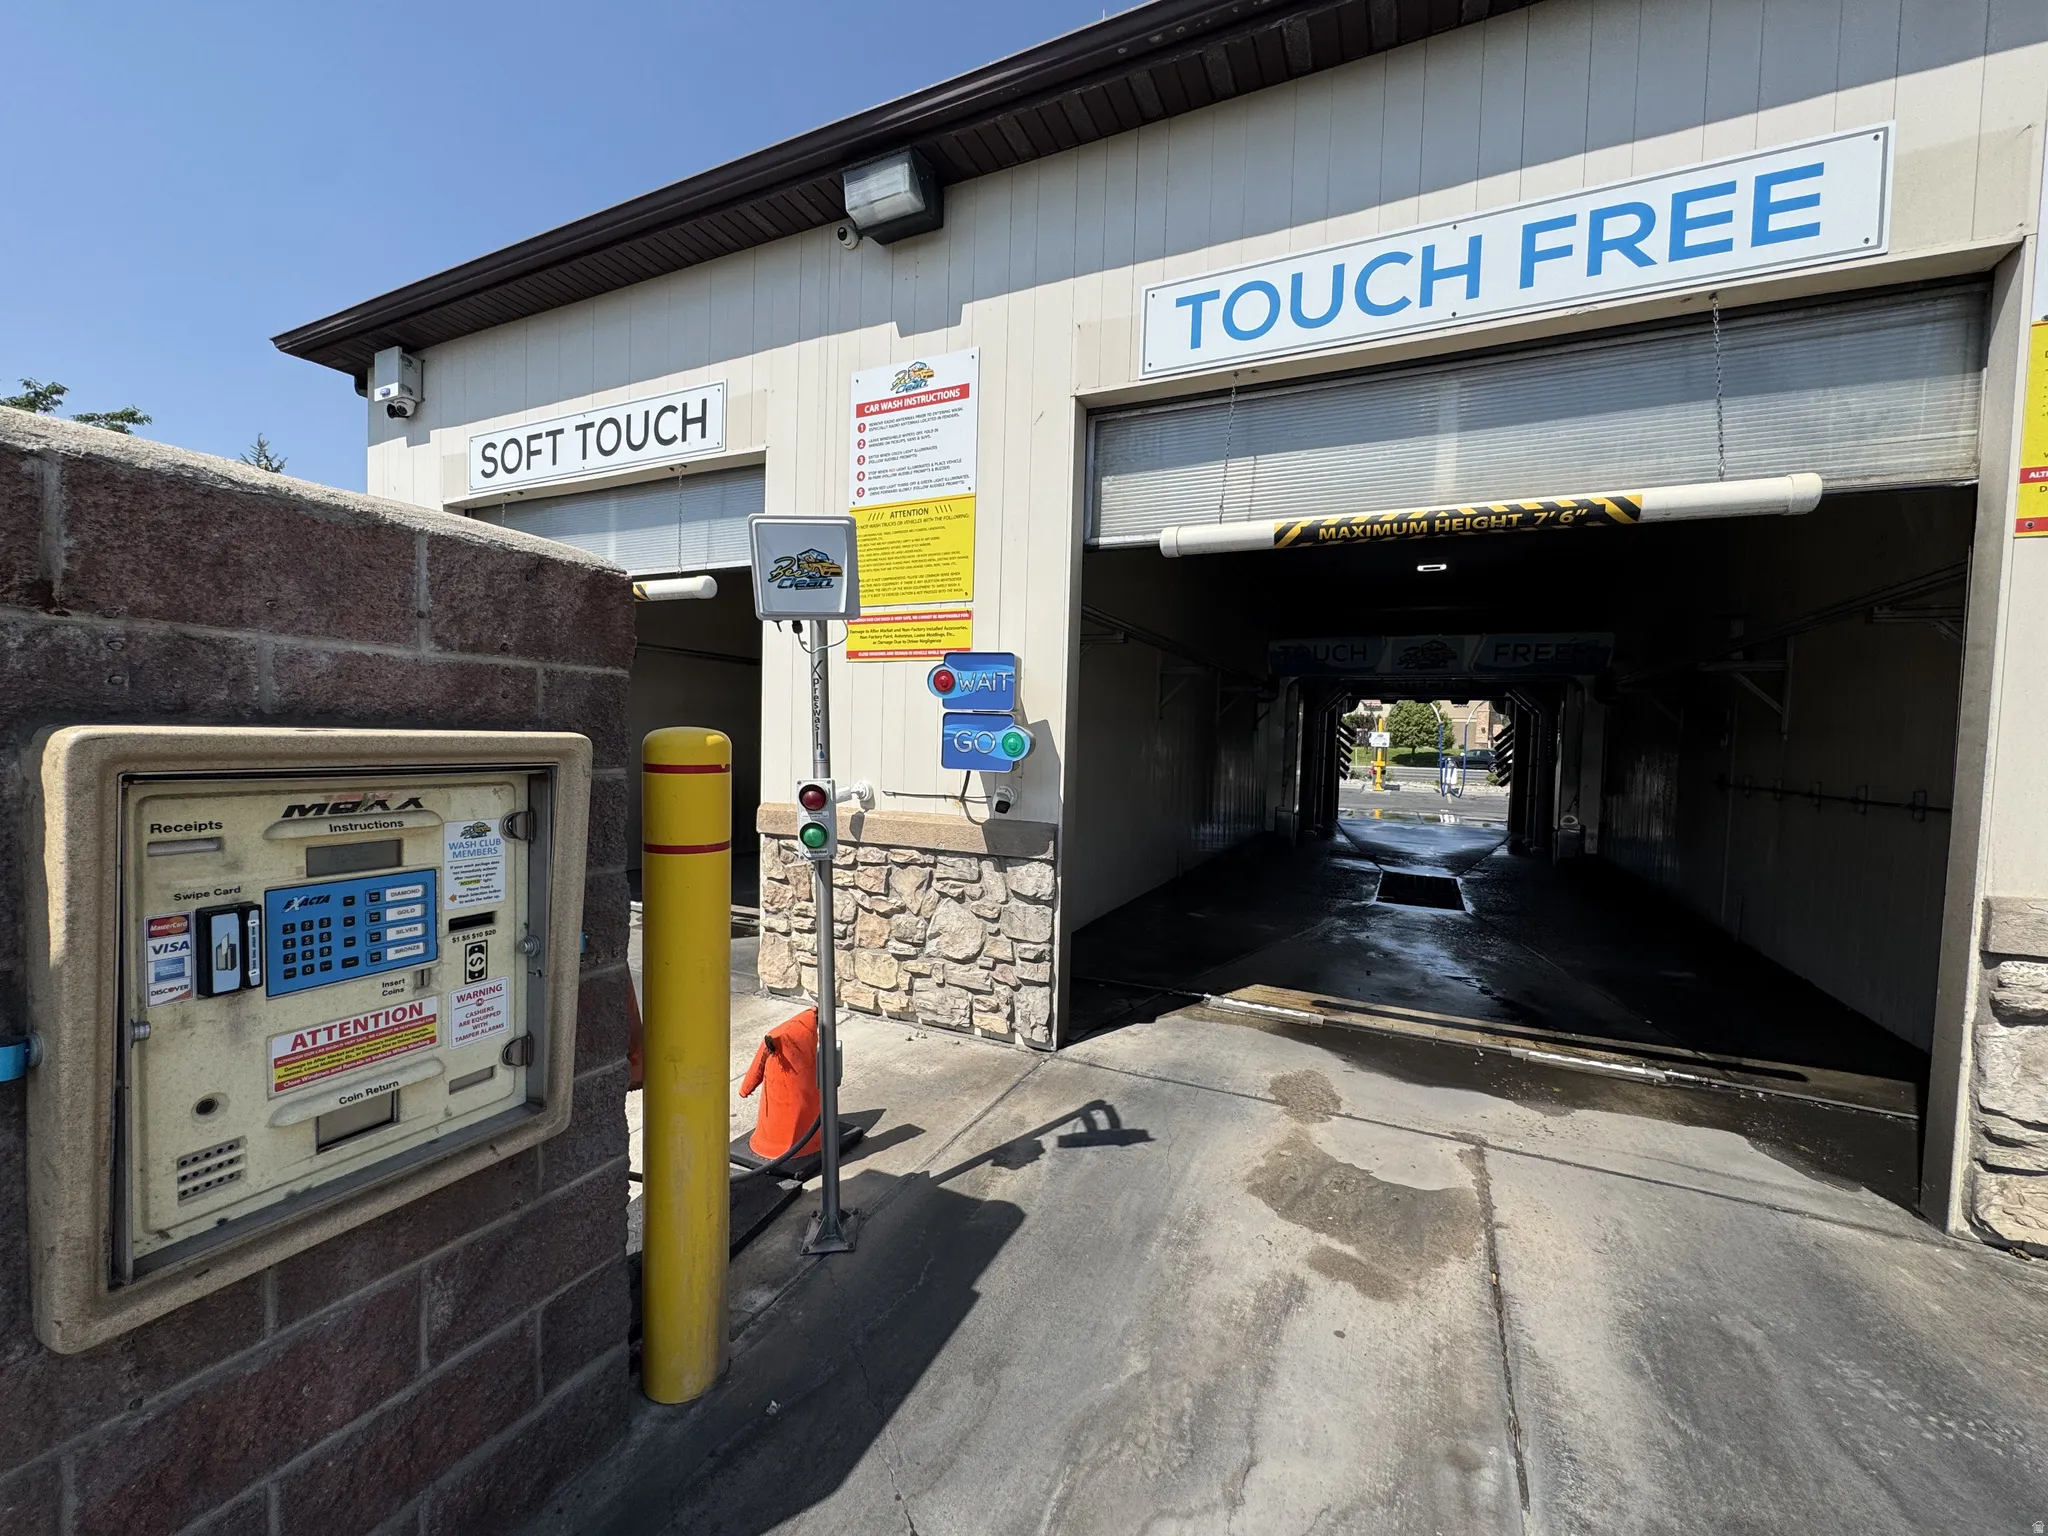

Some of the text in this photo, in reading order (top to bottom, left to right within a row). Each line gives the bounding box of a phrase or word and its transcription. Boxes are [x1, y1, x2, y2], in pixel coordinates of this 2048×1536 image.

[1175, 162, 1825, 350] TOUCH FREE
[864, 388, 960, 414] CAR WASH INSTRUCTIONS
[480, 398, 707, 479] SOFT TOUCH
[890, 508, 929, 519] ATTENTION
[1318, 520, 1428, 540] MAXIMUM
[1434, 513, 1522, 535] HEIGHT
[769, 556, 809, 581] Bee
[778, 577, 834, 591] Clean
[957, 671, 1013, 692] WAIT
[811, 660, 823, 750] Xpreswash
[954, 730, 996, 754] GO
[150, 820, 223, 834] Receipts
[329, 819, 404, 832] Instructions
[448, 838, 501, 851] WASH CLUB
[452, 846, 498, 859] MEMBERS
[174, 886, 241, 901] Swipe Card
[391, 889, 420, 897] DIAMOND
[282, 894, 331, 913] EXACTA
[150, 921, 188, 931] MasterCard
[472, 932, 484, 940] $10
[484, 929, 497, 937] $20
[151, 941, 190, 954] VISA
[395, 945, 420, 954] BRONZE
[151, 984, 189, 996] DISCOVER
[382, 978, 405, 988] Insert
[382, 987, 404, 996] Coins
[456, 984, 503, 1003] WARNING
[466, 1006, 494, 1019] CASHIERS
[290, 1001, 423, 1052] ATTENTION
[459, 1011, 501, 1029] ARE EQUIPPED
[472, 1021, 488, 1030] WITH
[455, 1023, 505, 1042] TAMPER ALARMS
[339, 1080, 399, 1105] Coin Return
